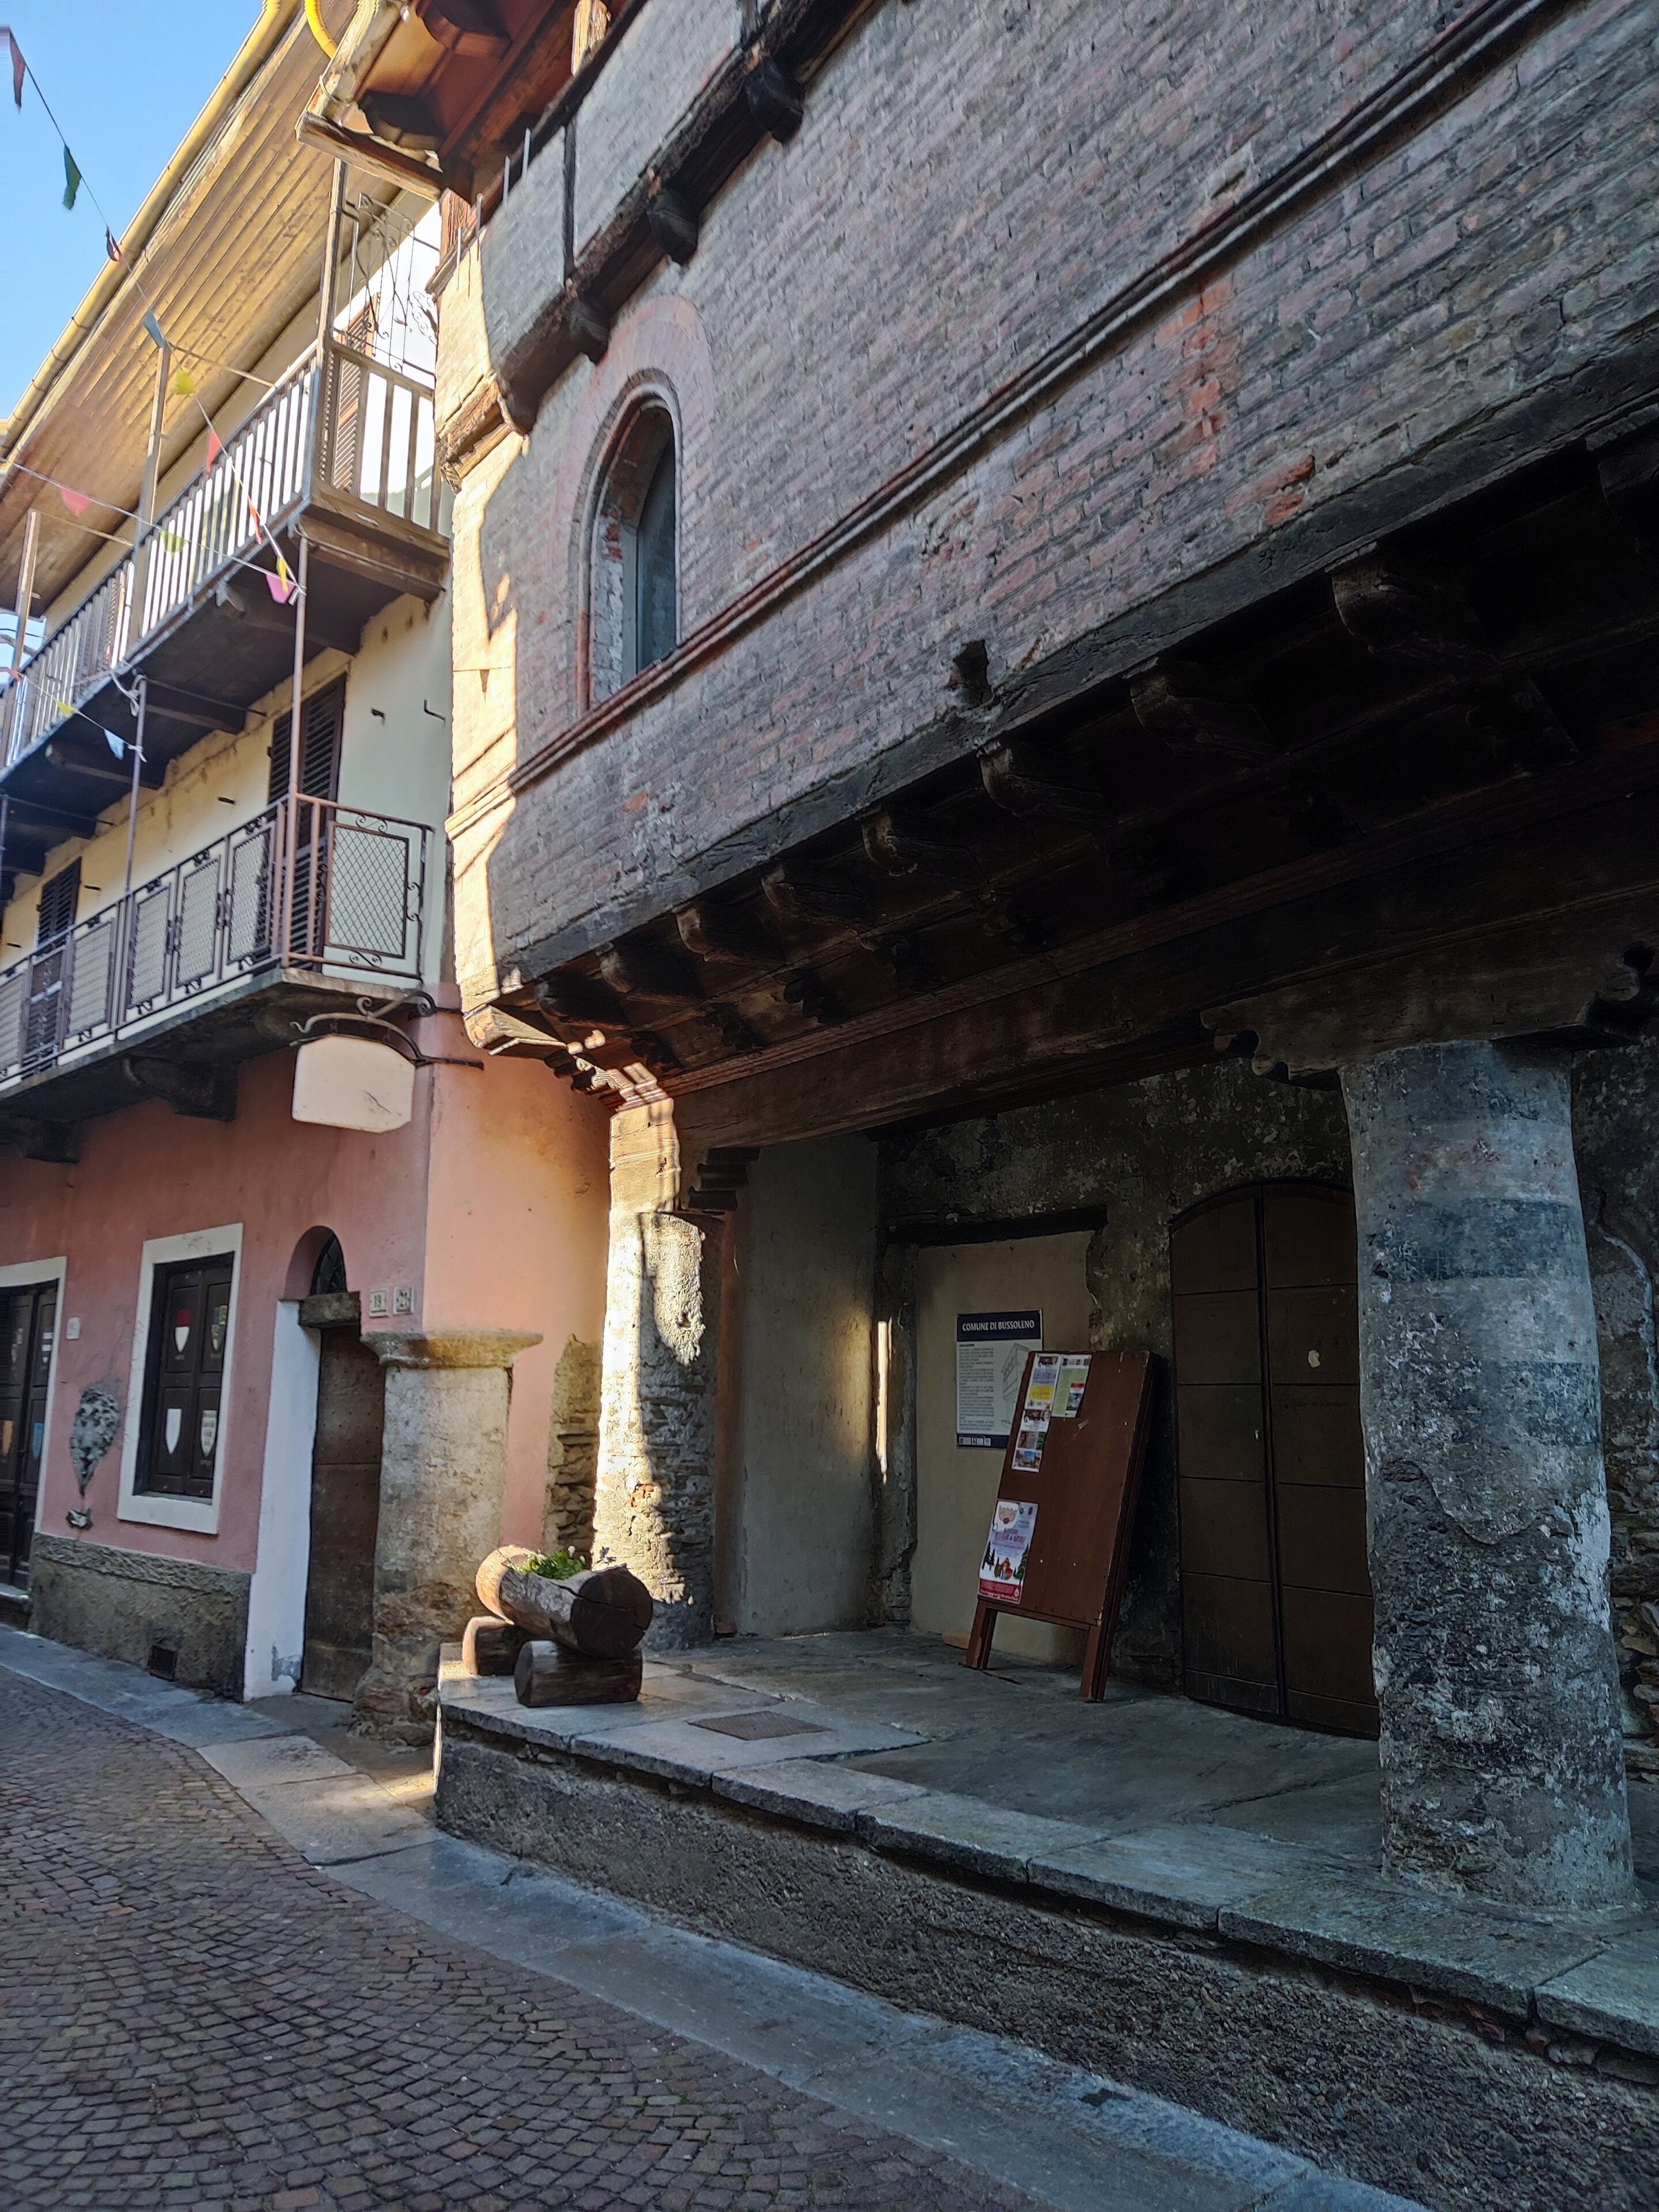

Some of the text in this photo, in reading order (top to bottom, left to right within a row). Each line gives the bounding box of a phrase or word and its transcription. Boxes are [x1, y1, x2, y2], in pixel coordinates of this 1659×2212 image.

[963, 1320, 1035, 1331] COMUNE DI BUSSOLENO
